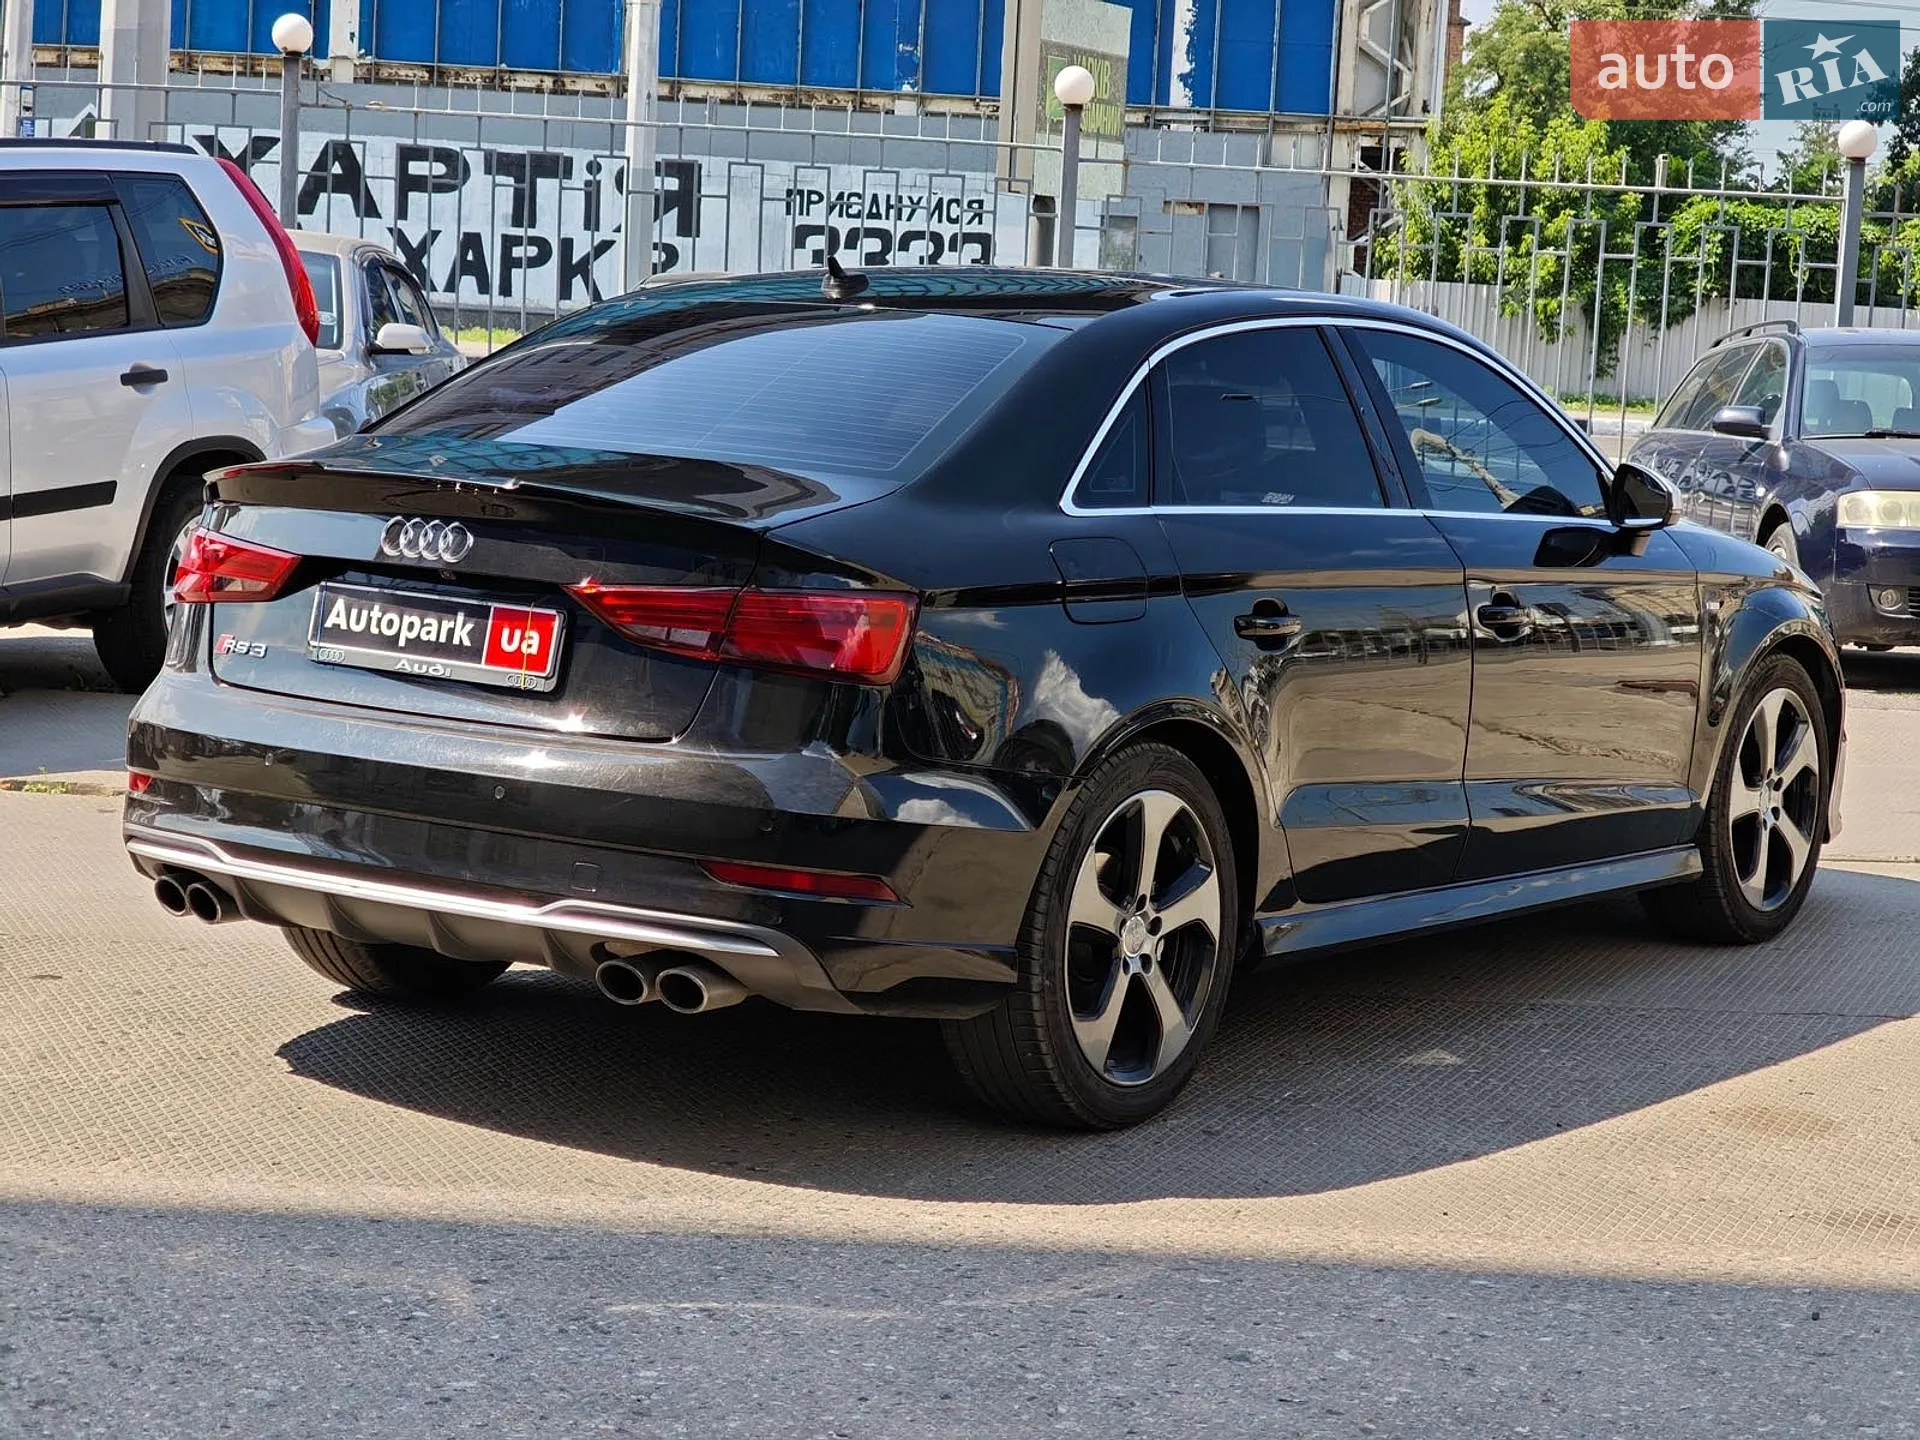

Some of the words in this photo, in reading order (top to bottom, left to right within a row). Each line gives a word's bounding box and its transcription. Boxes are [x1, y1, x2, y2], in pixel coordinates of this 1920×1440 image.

[324, 598, 475, 648] Autopark
[499, 625, 541, 656] ua
[215, 633, 268, 659] RS3
[394, 659, 452, 678] Audi
